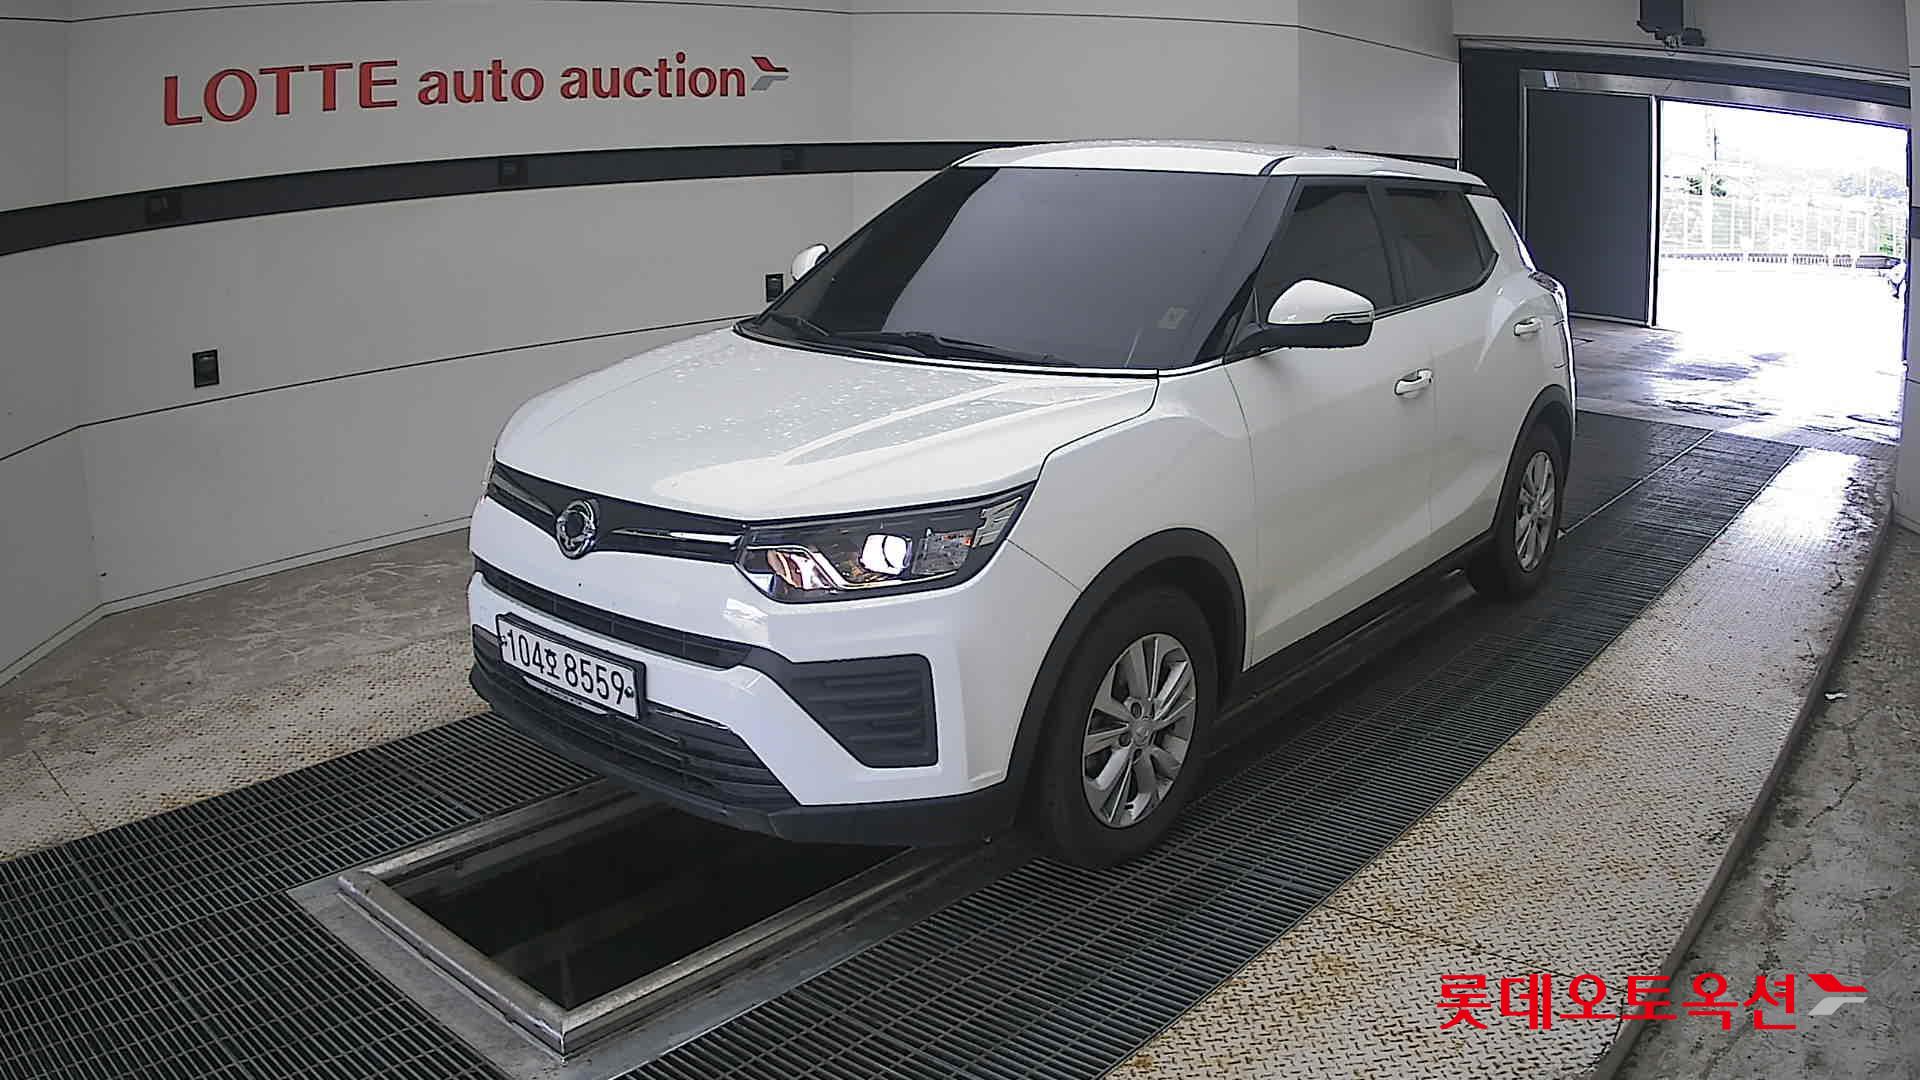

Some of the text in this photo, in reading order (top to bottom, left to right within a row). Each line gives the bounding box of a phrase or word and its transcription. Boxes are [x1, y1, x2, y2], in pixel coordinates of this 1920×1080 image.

[163, 52, 747, 126] LOTTE auto auction
[507, 629, 625, 705] 104호 8559
